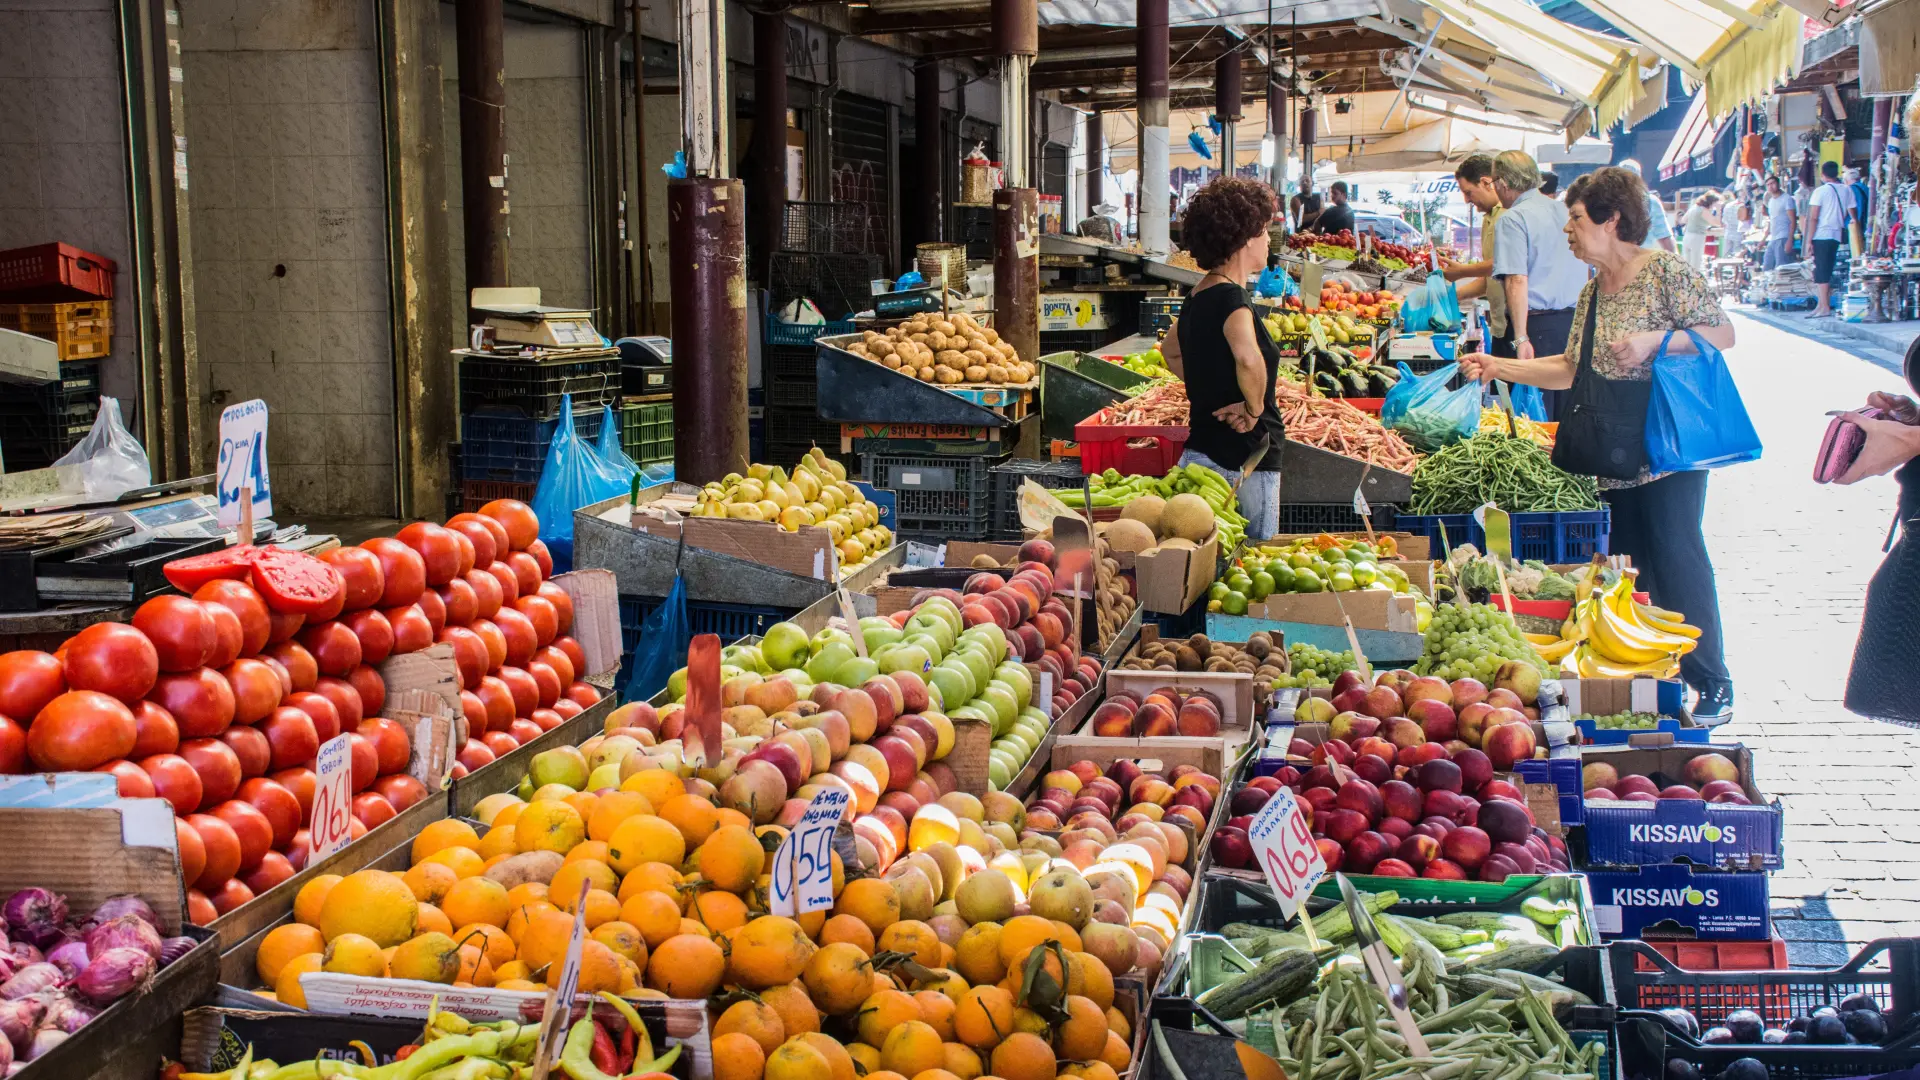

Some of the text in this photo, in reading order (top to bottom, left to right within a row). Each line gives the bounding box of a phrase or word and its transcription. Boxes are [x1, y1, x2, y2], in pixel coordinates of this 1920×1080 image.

[1044, 303, 1073, 317] BONITA
[890, 424, 966, 438] Fresh Fruits
[1629, 821, 1737, 845] KISSAVOS
[1611, 885, 1719, 907] KISSAVOS
